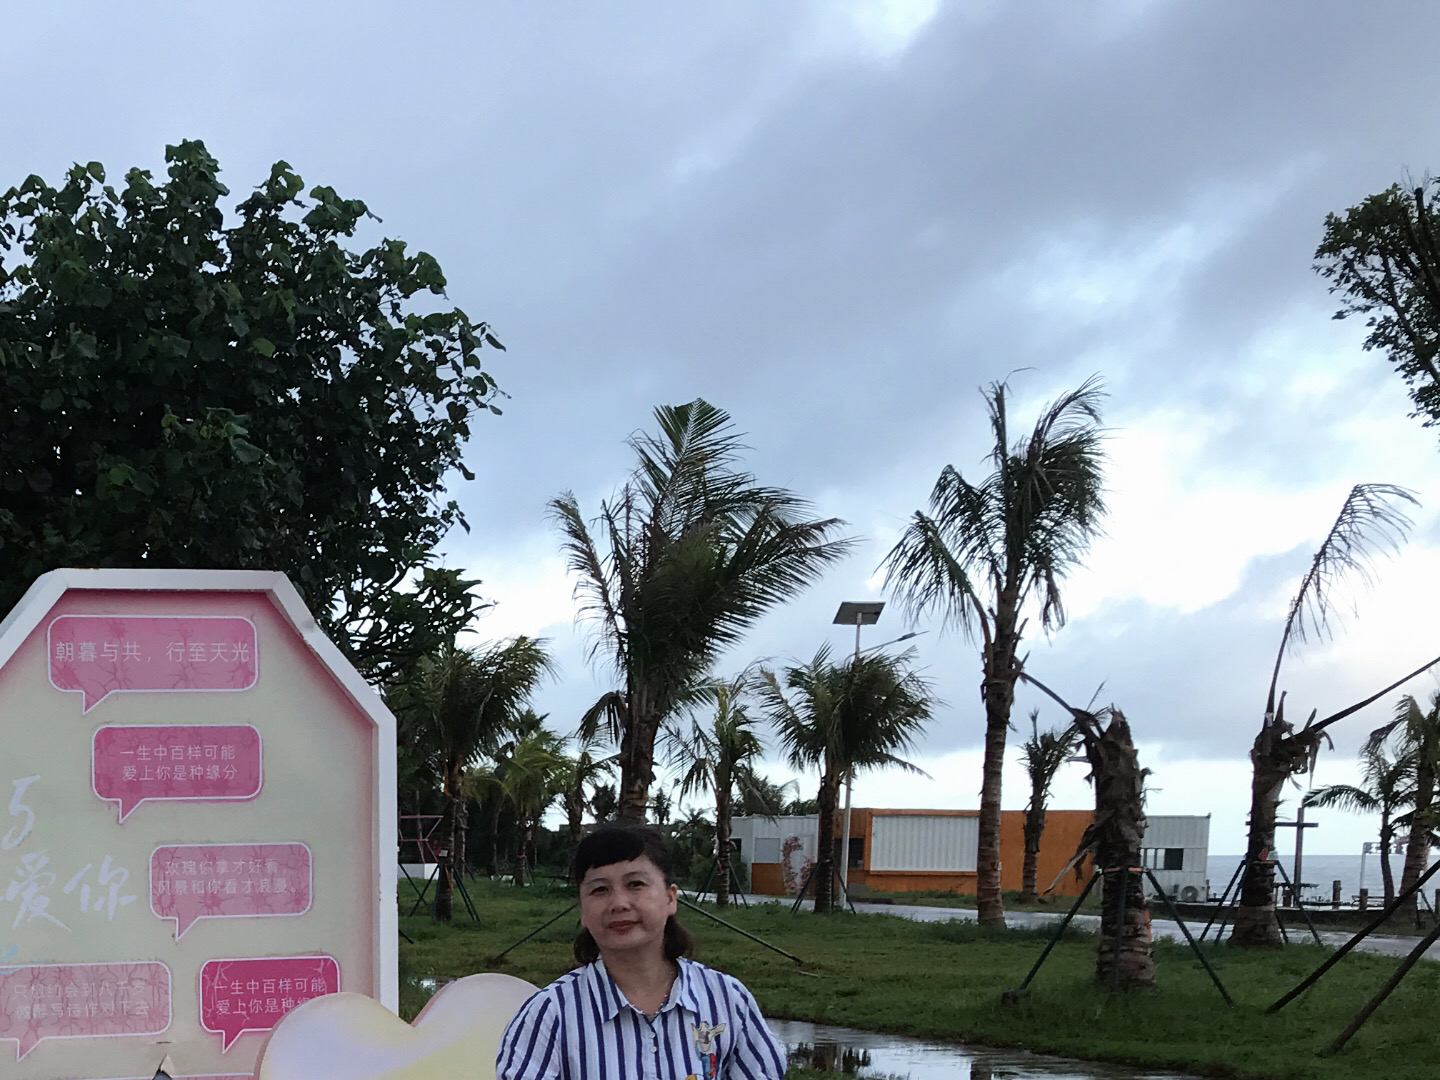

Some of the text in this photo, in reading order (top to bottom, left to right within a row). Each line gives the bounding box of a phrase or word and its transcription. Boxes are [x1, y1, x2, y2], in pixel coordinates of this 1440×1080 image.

[120, 744, 236, 761] 一生中百样可能
[122, 764, 238, 781] 爱上你是种缘分
[215, 978, 326, 995] 一生中百样可能
